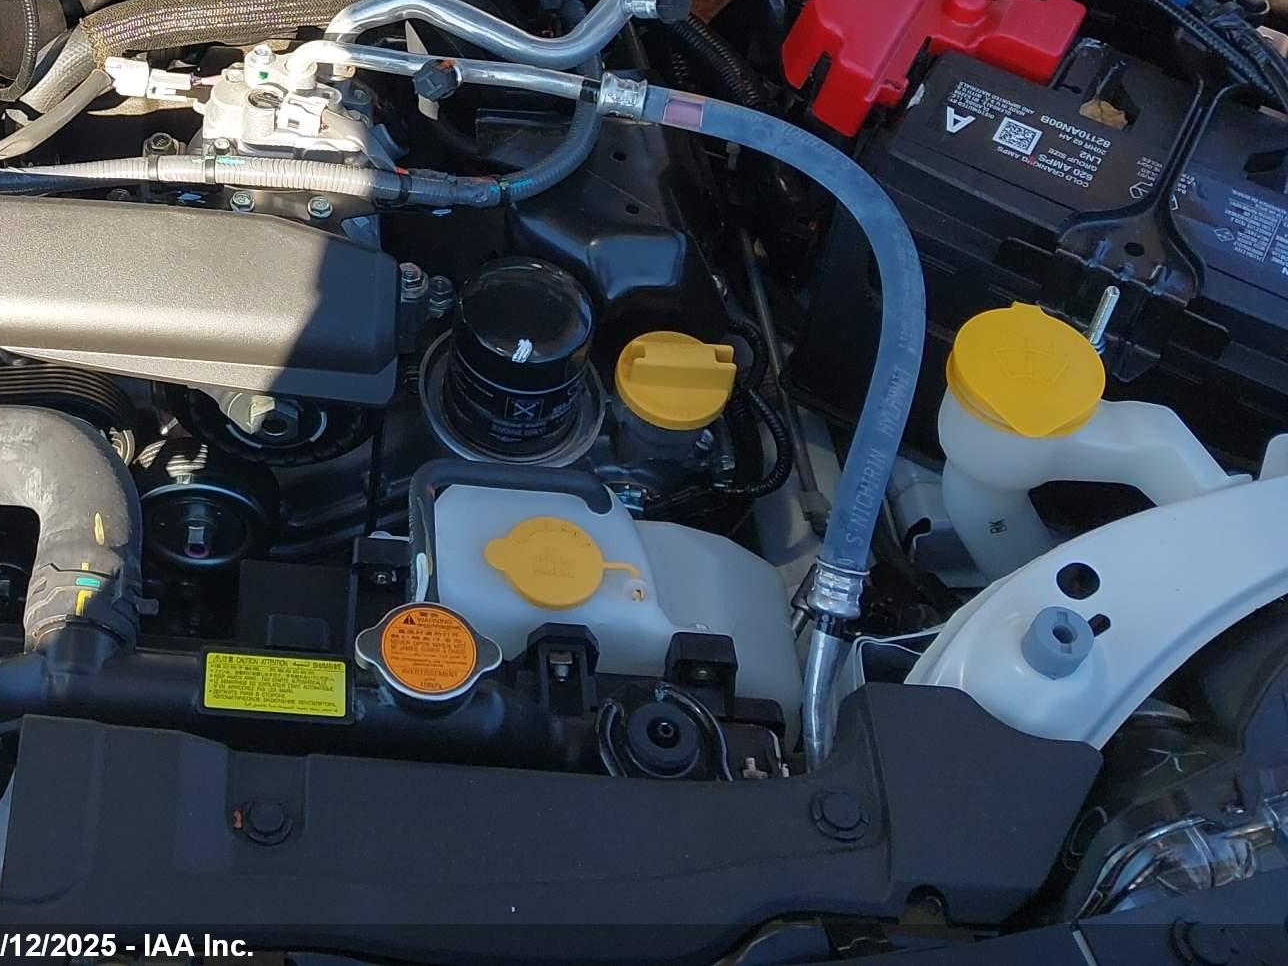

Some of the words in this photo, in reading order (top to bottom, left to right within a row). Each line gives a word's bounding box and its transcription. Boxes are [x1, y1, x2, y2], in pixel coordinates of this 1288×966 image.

[946, 105, 976, 134] A
[1040, 115, 1111, 148] 82110AN00B
[1058, 133, 1072, 142] AH
[1072, 138, 1084, 146] 62
[996, 145, 1021, 159] AMPS
[1048, 147, 1067, 160] SIZE
[1079, 150, 1102, 165] LN2
[1038, 154, 1072, 172] AMPS
[1067, 157, 1098, 172] GROUP
[1073, 168, 1093, 181] 620
[1065, 175, 1089, 188] COLD
[236, 657, 259, 665] CAUTION
[261, 659, 288, 668] ATTENTION
